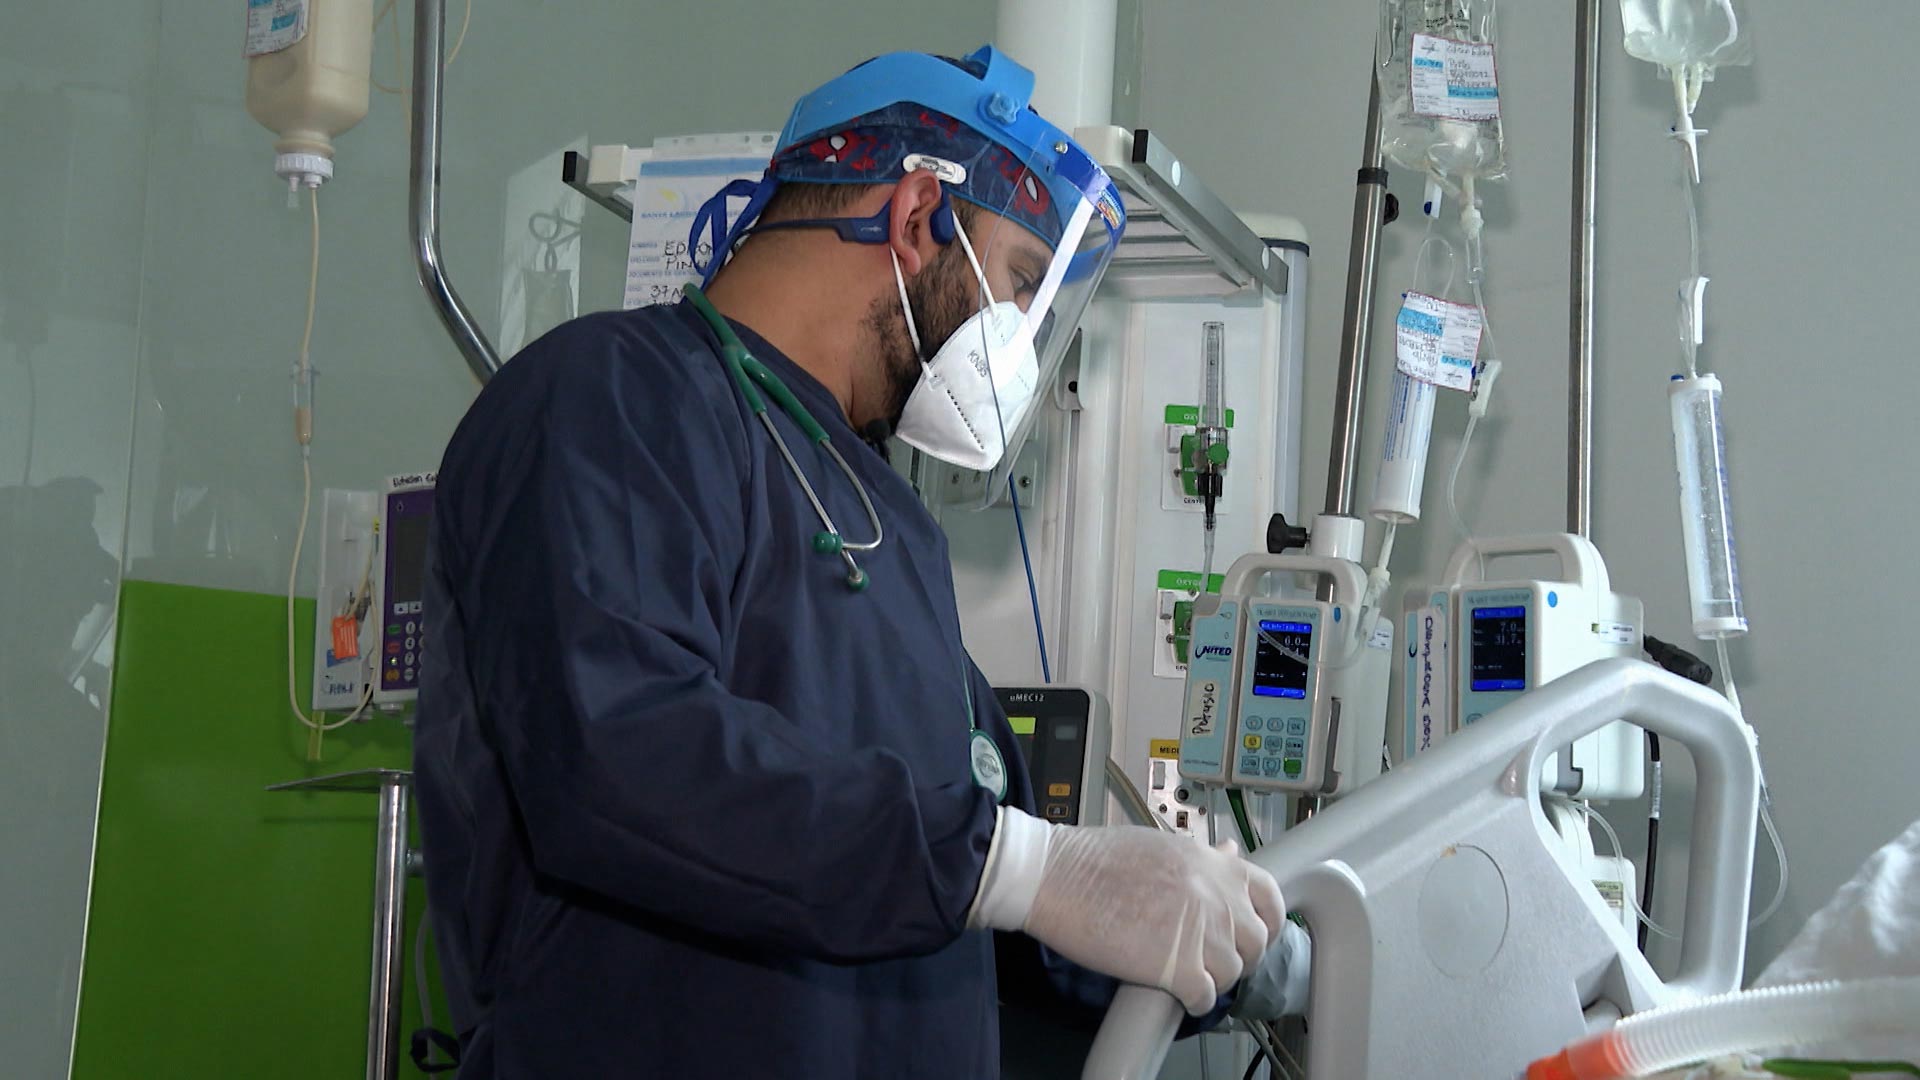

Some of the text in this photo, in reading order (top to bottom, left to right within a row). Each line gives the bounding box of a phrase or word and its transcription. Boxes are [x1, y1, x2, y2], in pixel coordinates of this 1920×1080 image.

[966, 349, 987, 378] KN95
[1184, 413, 1198, 421] OXY
[1176, 577, 1201, 586] OXYG
[1194, 645, 1232, 659] UNITED
[1009, 693, 1045, 703] uMEC12
[1160, 746, 1179, 754] MEDI
